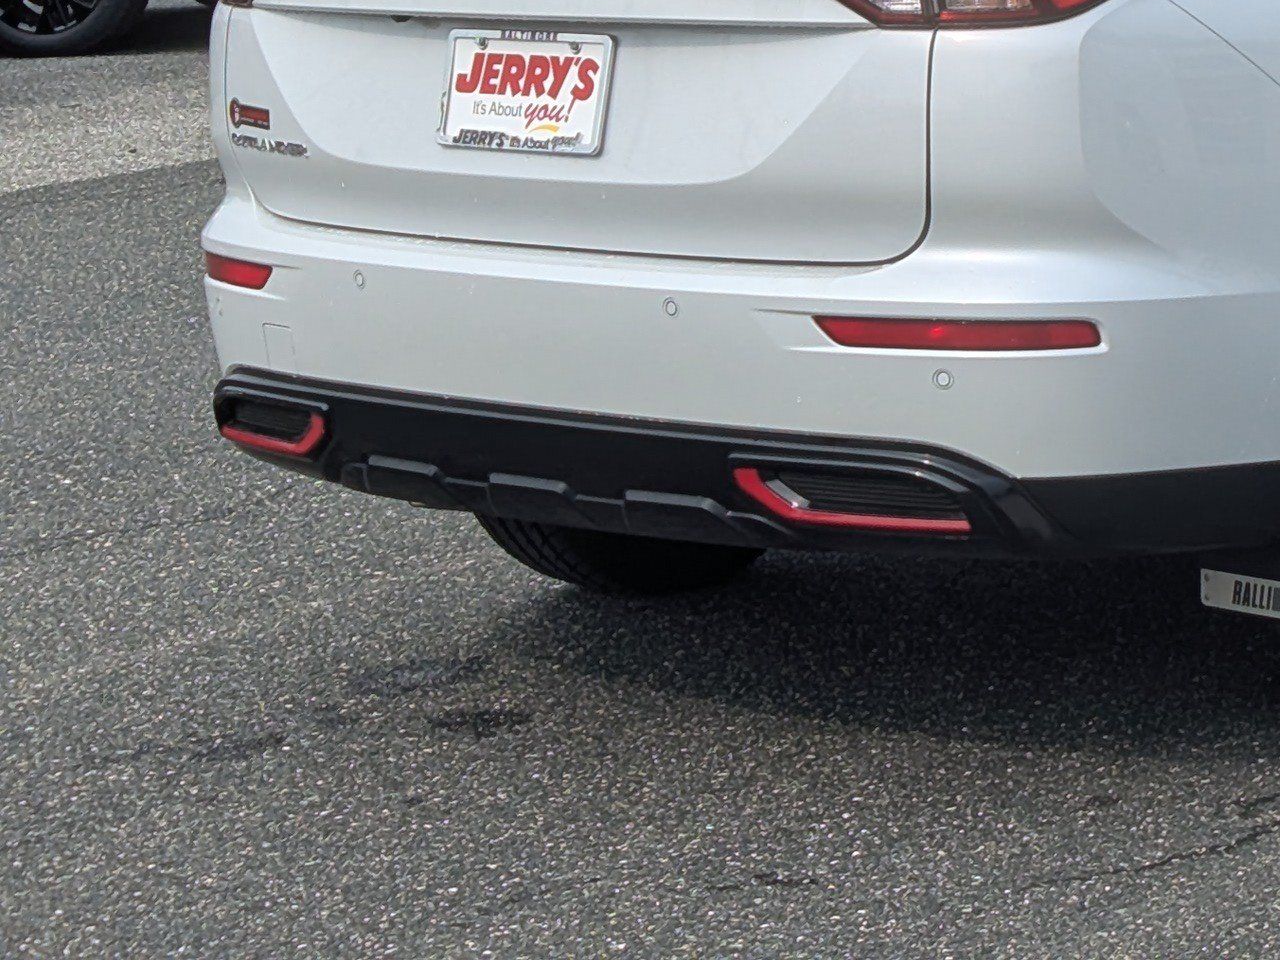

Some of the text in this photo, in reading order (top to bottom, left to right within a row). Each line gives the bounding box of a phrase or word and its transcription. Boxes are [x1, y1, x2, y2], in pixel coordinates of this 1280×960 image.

[455, 52, 600, 101] JERRY'S
[473, 98, 575, 129] It's About you!
